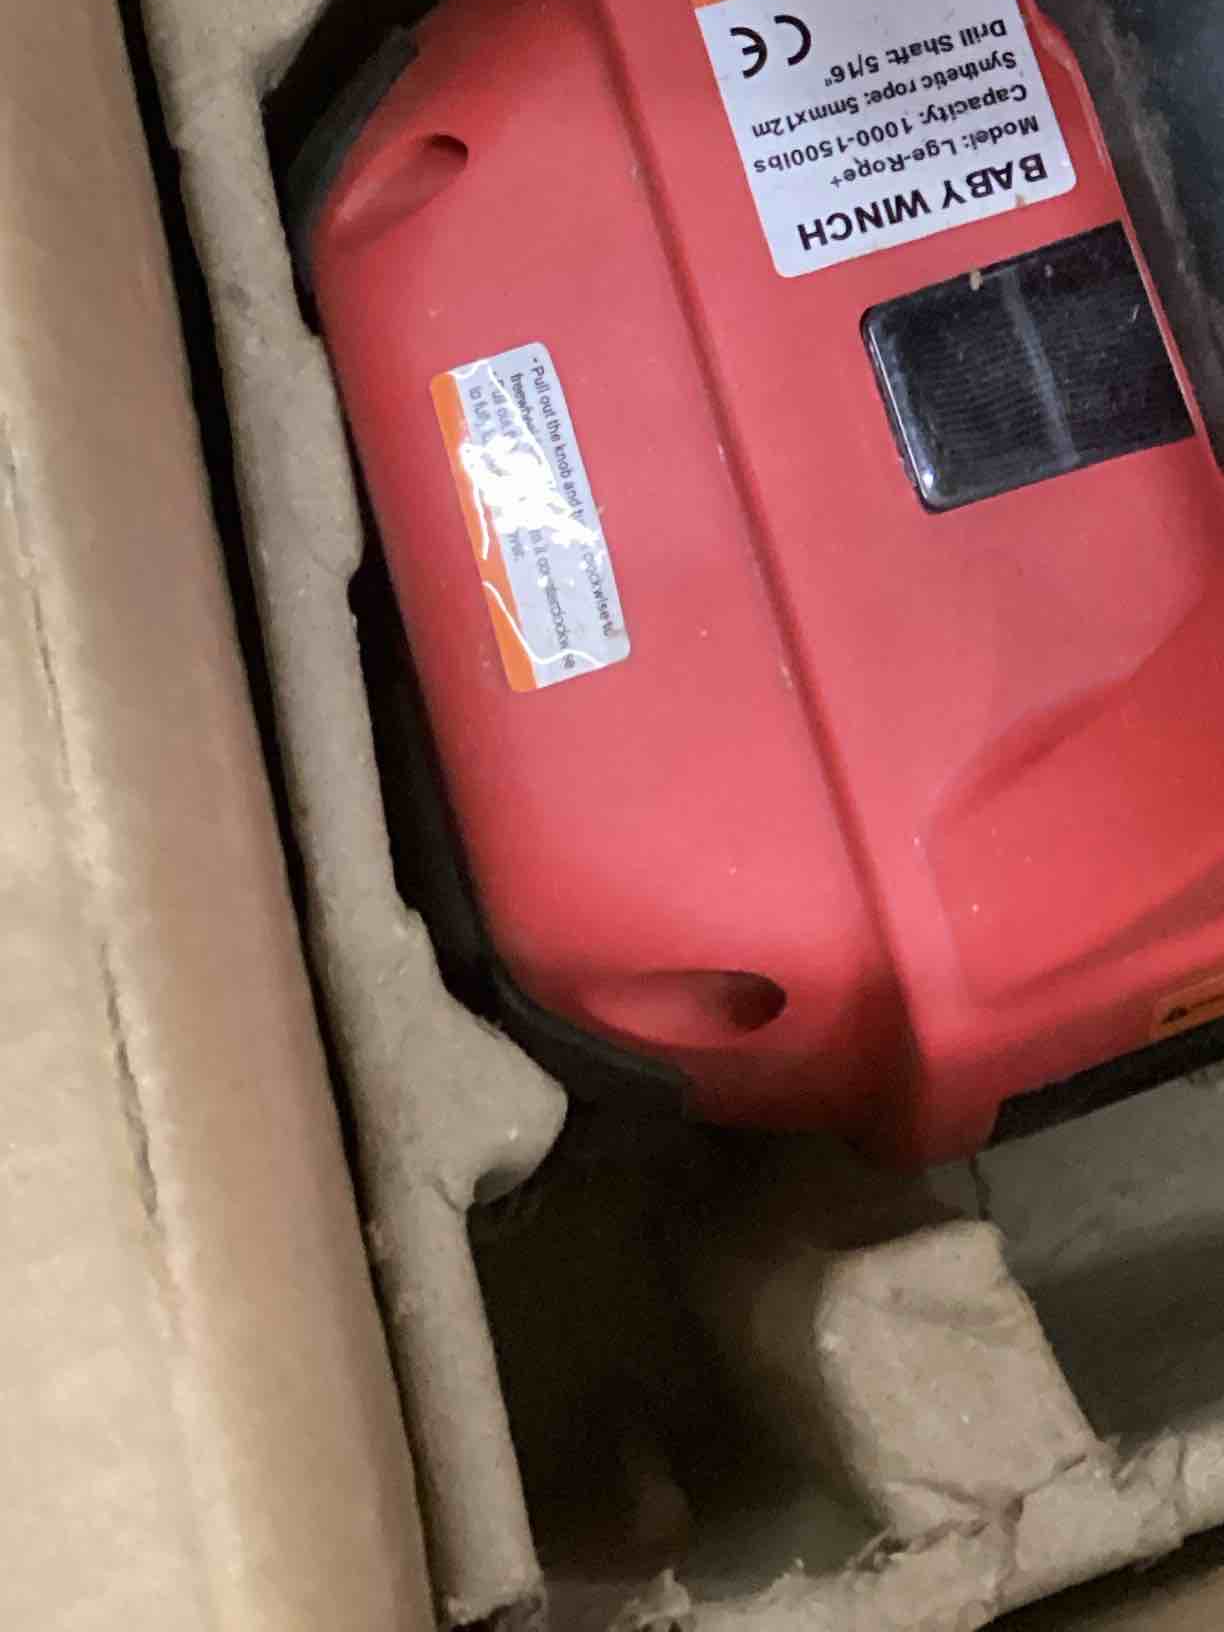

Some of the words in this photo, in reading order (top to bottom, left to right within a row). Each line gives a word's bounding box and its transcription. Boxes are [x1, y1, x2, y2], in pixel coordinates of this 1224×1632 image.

[884, 34, 954, 65] Shaft:
[958, 18, 1007, 47] Drill
[919, 49, 1017, 90] Synthetic
[863, 78, 917, 105] rope:
[918, 83, 1027, 125] Capacity:
[751, 95, 860, 137] 5mmx12m
[961, 114, 1039, 150] Model:
[753, 116, 913, 173] 1000-1500lbs
[829, 137, 957, 187] Lge-Rope+
[941, 152, 1048, 209] BABY
[796, 188, 931, 251] WINCH
[530, 364, 549, 394] Pull
[538, 393, 555, 419] out
[546, 419, 563, 443] the
[552, 443, 574, 479] knob
[562, 479, 581, 508] and
